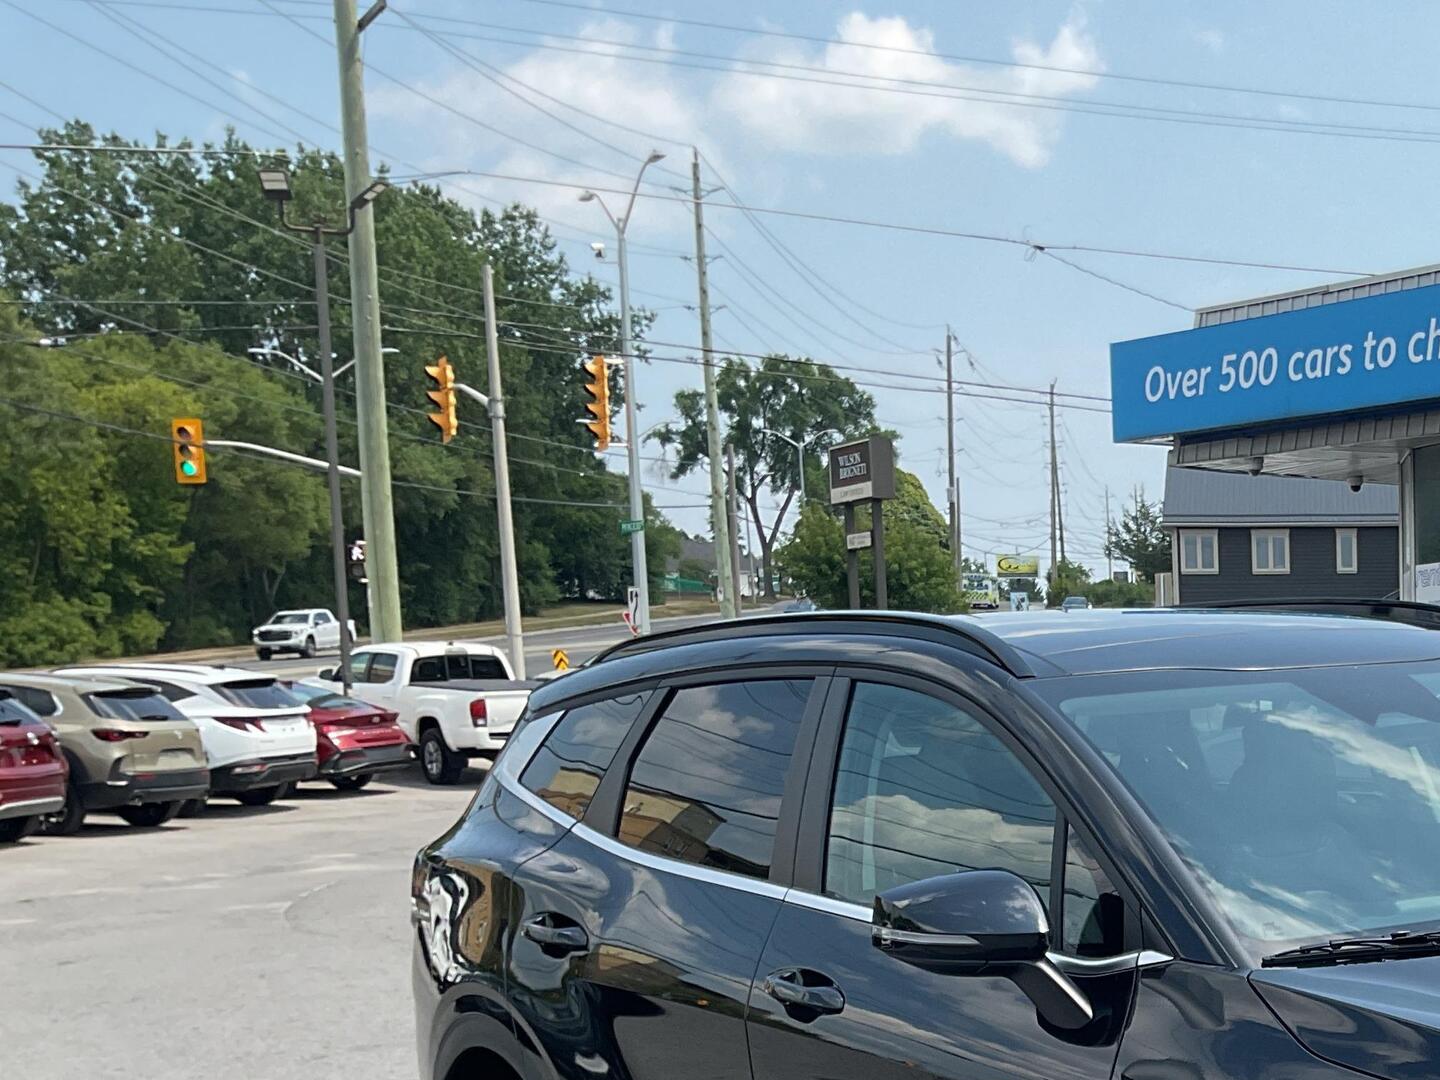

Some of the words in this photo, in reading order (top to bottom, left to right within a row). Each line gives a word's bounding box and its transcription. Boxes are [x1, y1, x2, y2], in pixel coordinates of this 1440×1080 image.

[1144, 365, 1211, 403] Over
[1218, 347, 1278, 392] 500
[1288, 344, 1353, 382] cars
[1364, 331, 1397, 371] to
